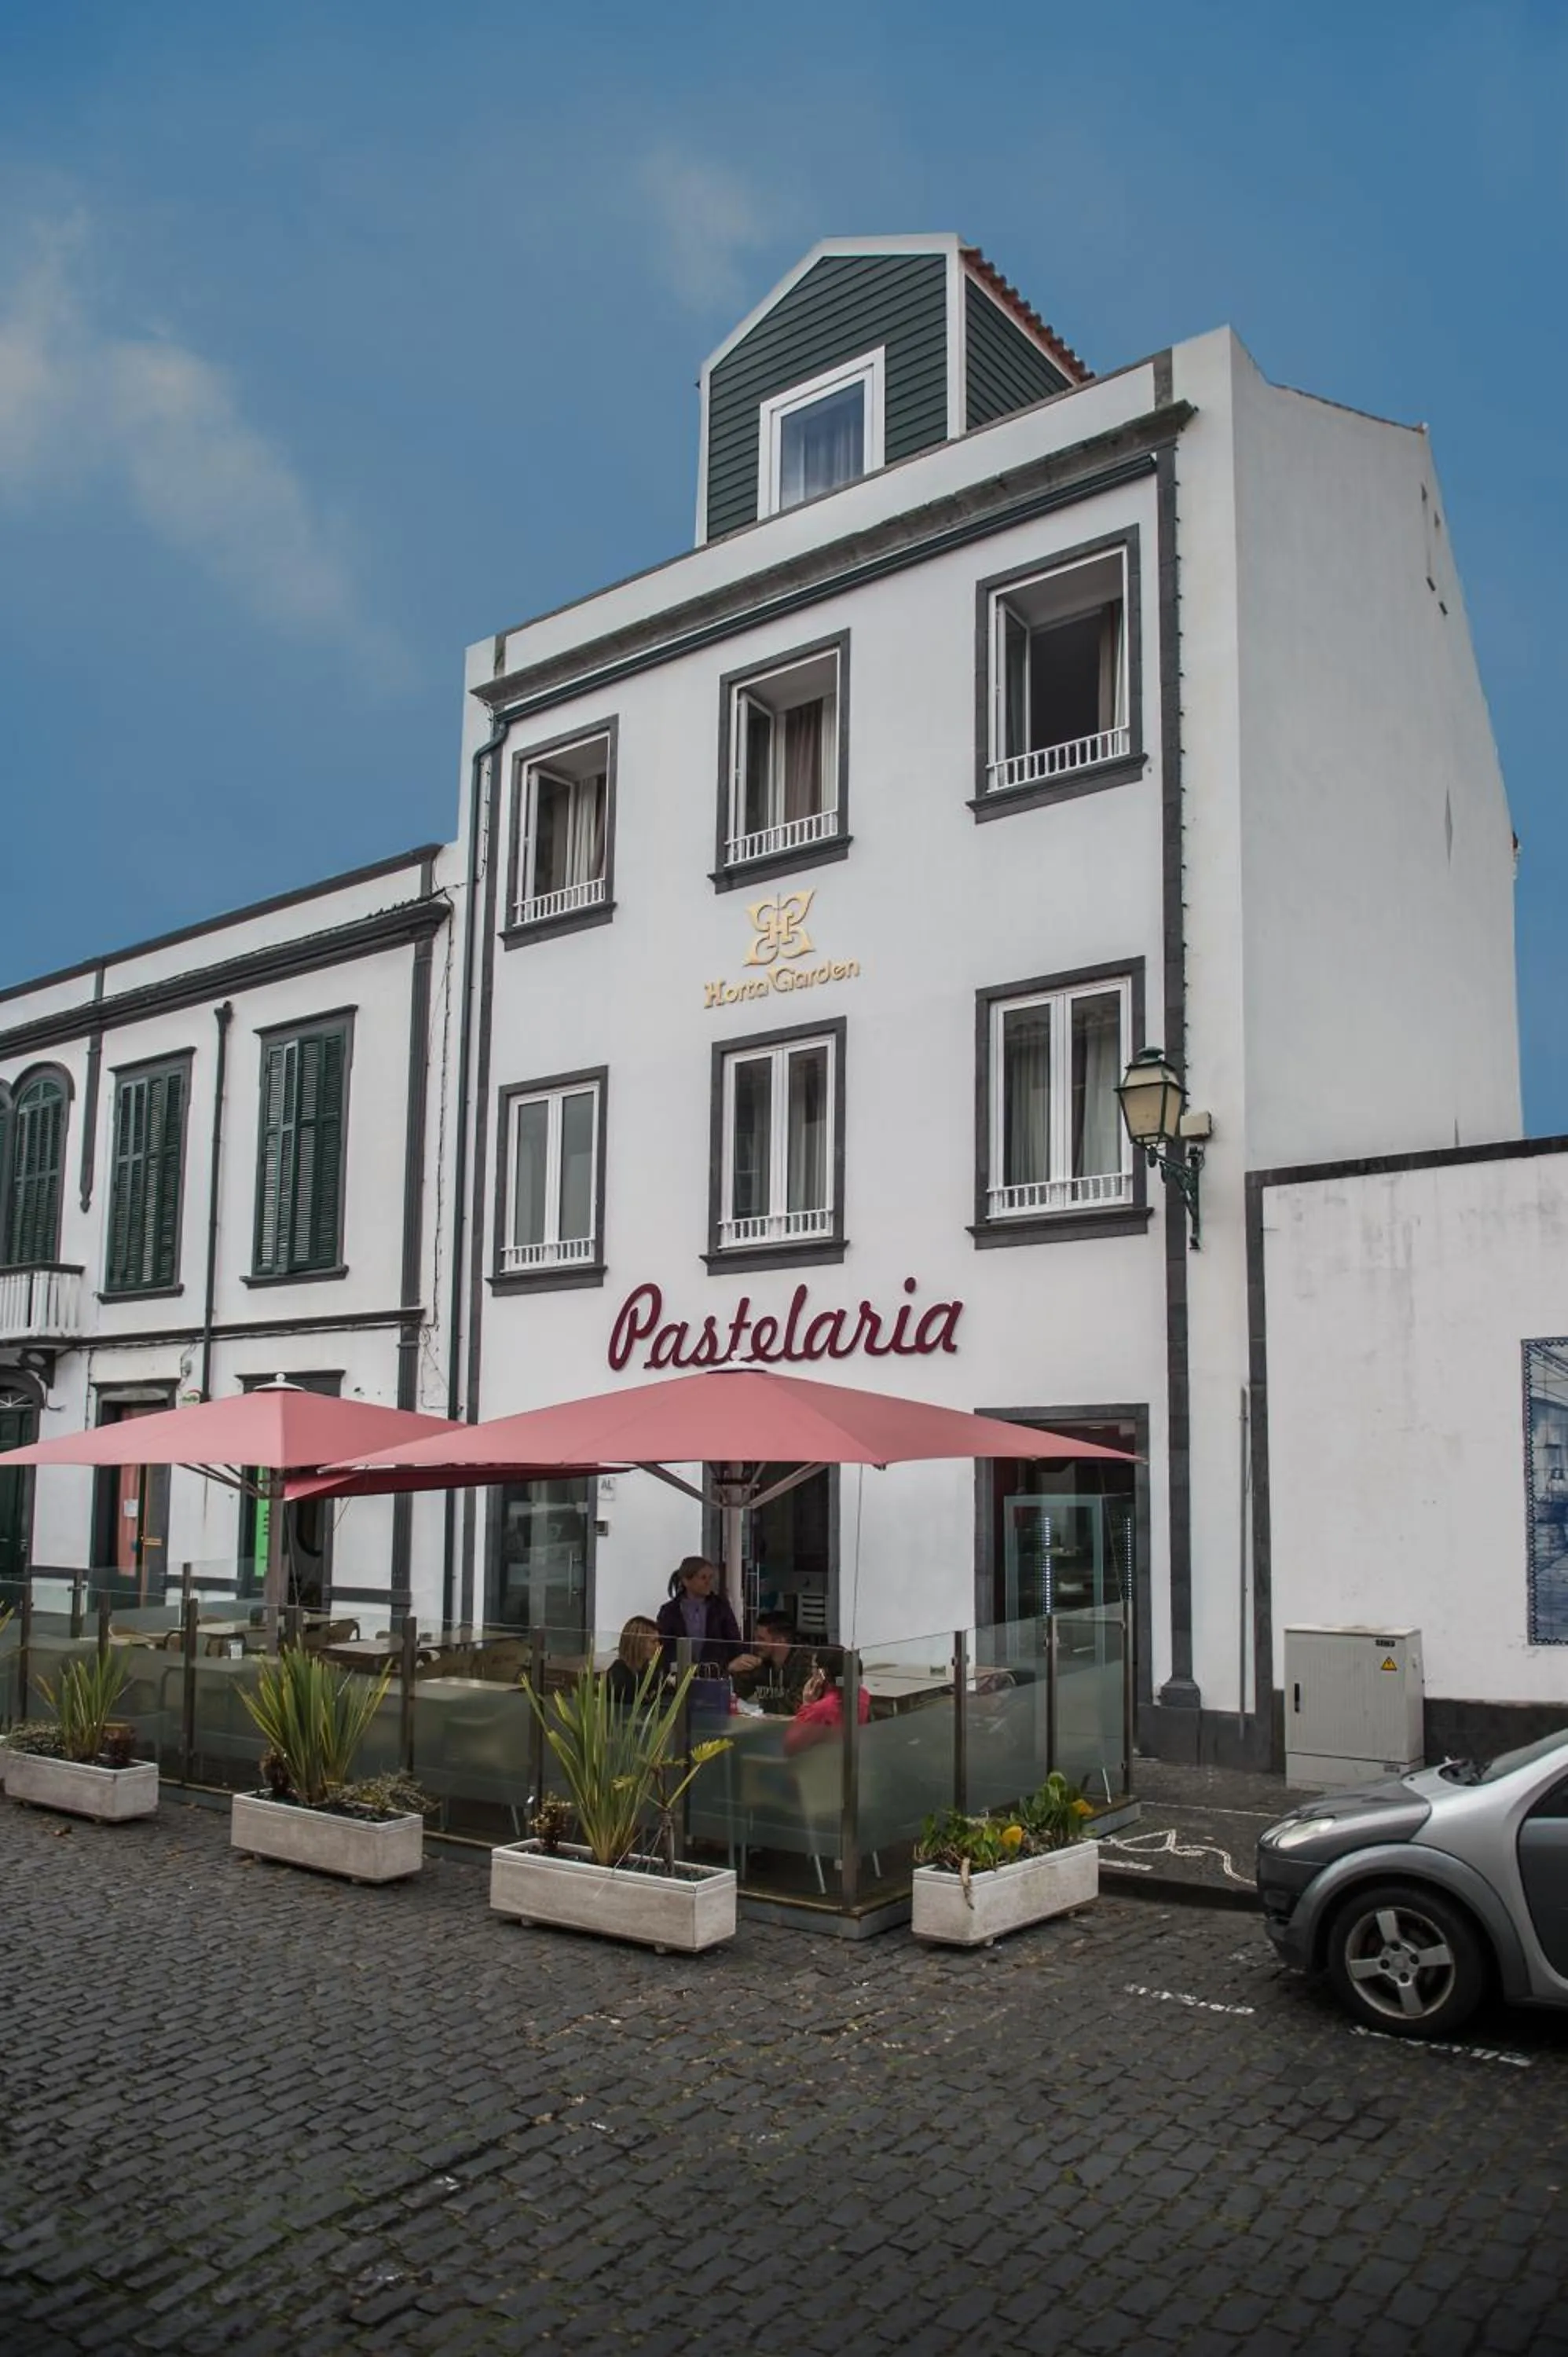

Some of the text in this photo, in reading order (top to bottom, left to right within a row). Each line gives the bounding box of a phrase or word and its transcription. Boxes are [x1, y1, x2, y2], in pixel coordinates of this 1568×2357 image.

[704, 959, 860, 1009] Horta Garden
[607, 1276, 964, 1371] Pastelaria
